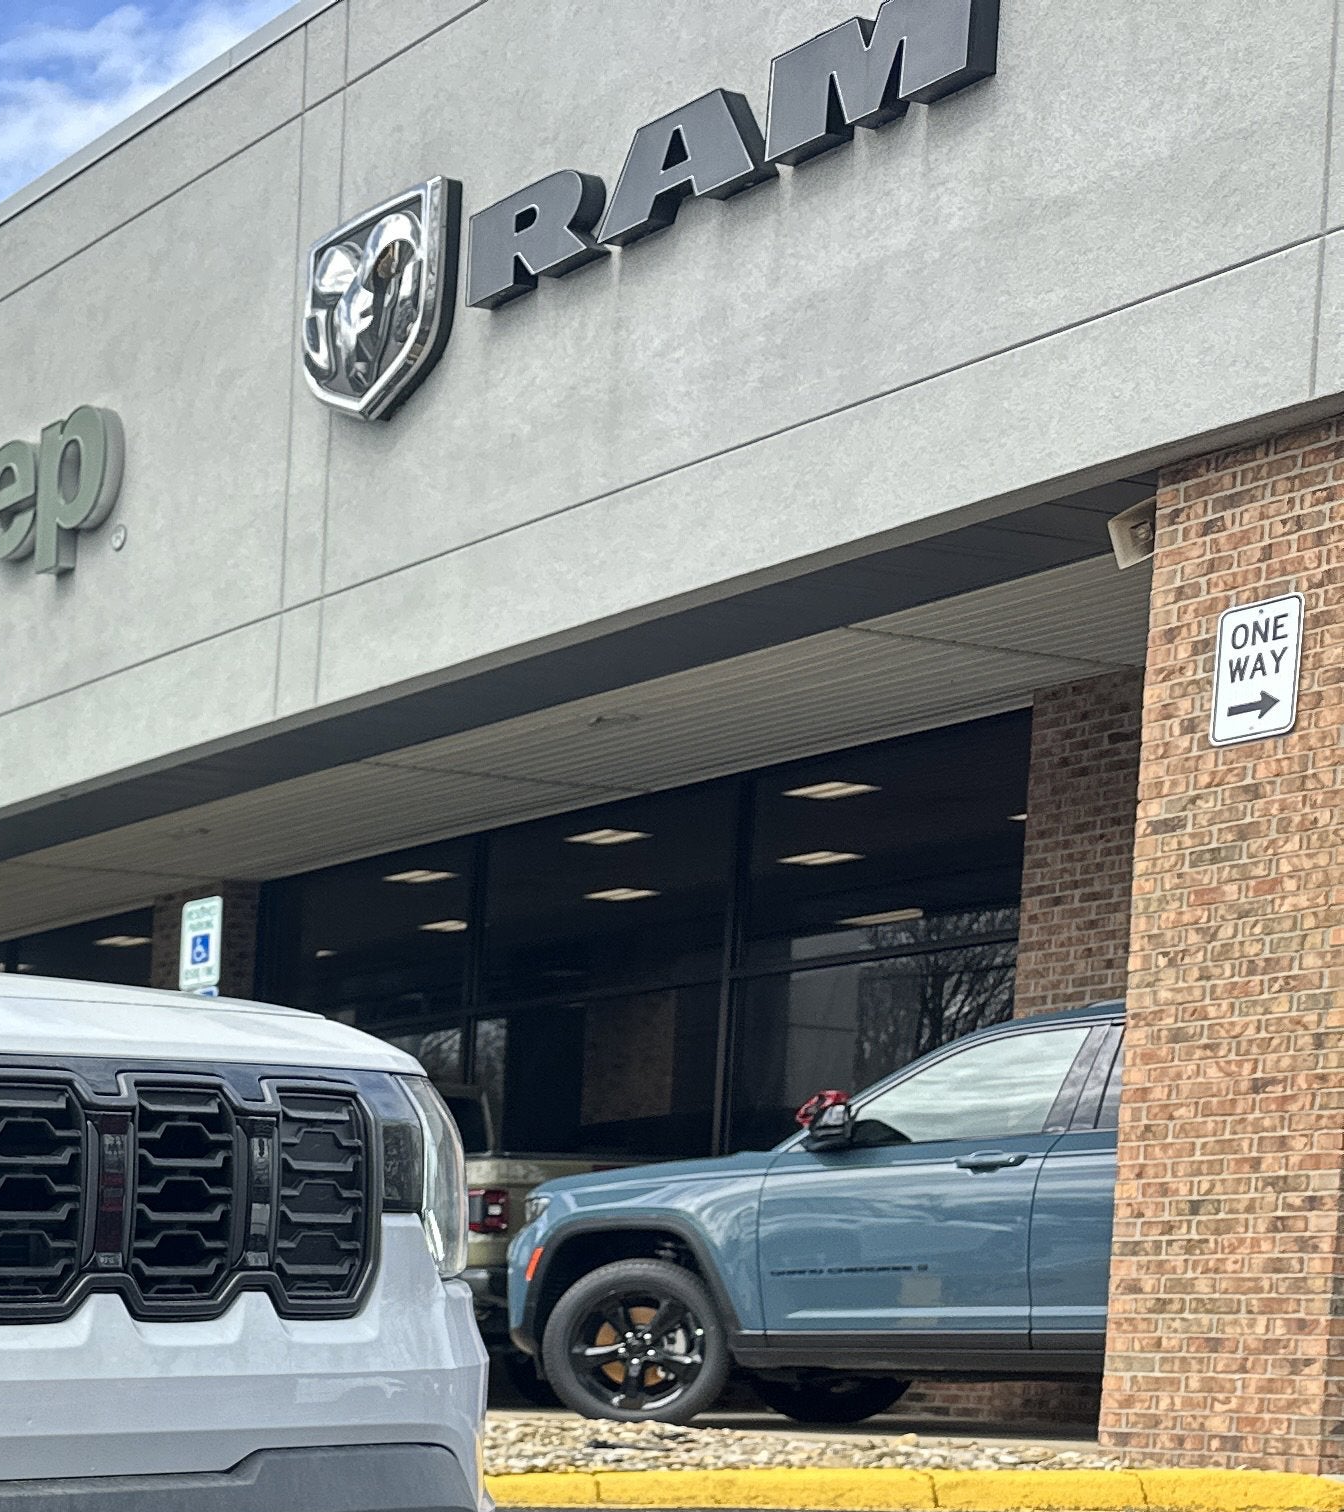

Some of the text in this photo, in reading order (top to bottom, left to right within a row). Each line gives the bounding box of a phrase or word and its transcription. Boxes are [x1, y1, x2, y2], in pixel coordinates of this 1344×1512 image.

[466, 0, 997, 309] RAM
[1231, 613, 1288, 649] ONE
[1229, 647, 1288, 683] WAY
